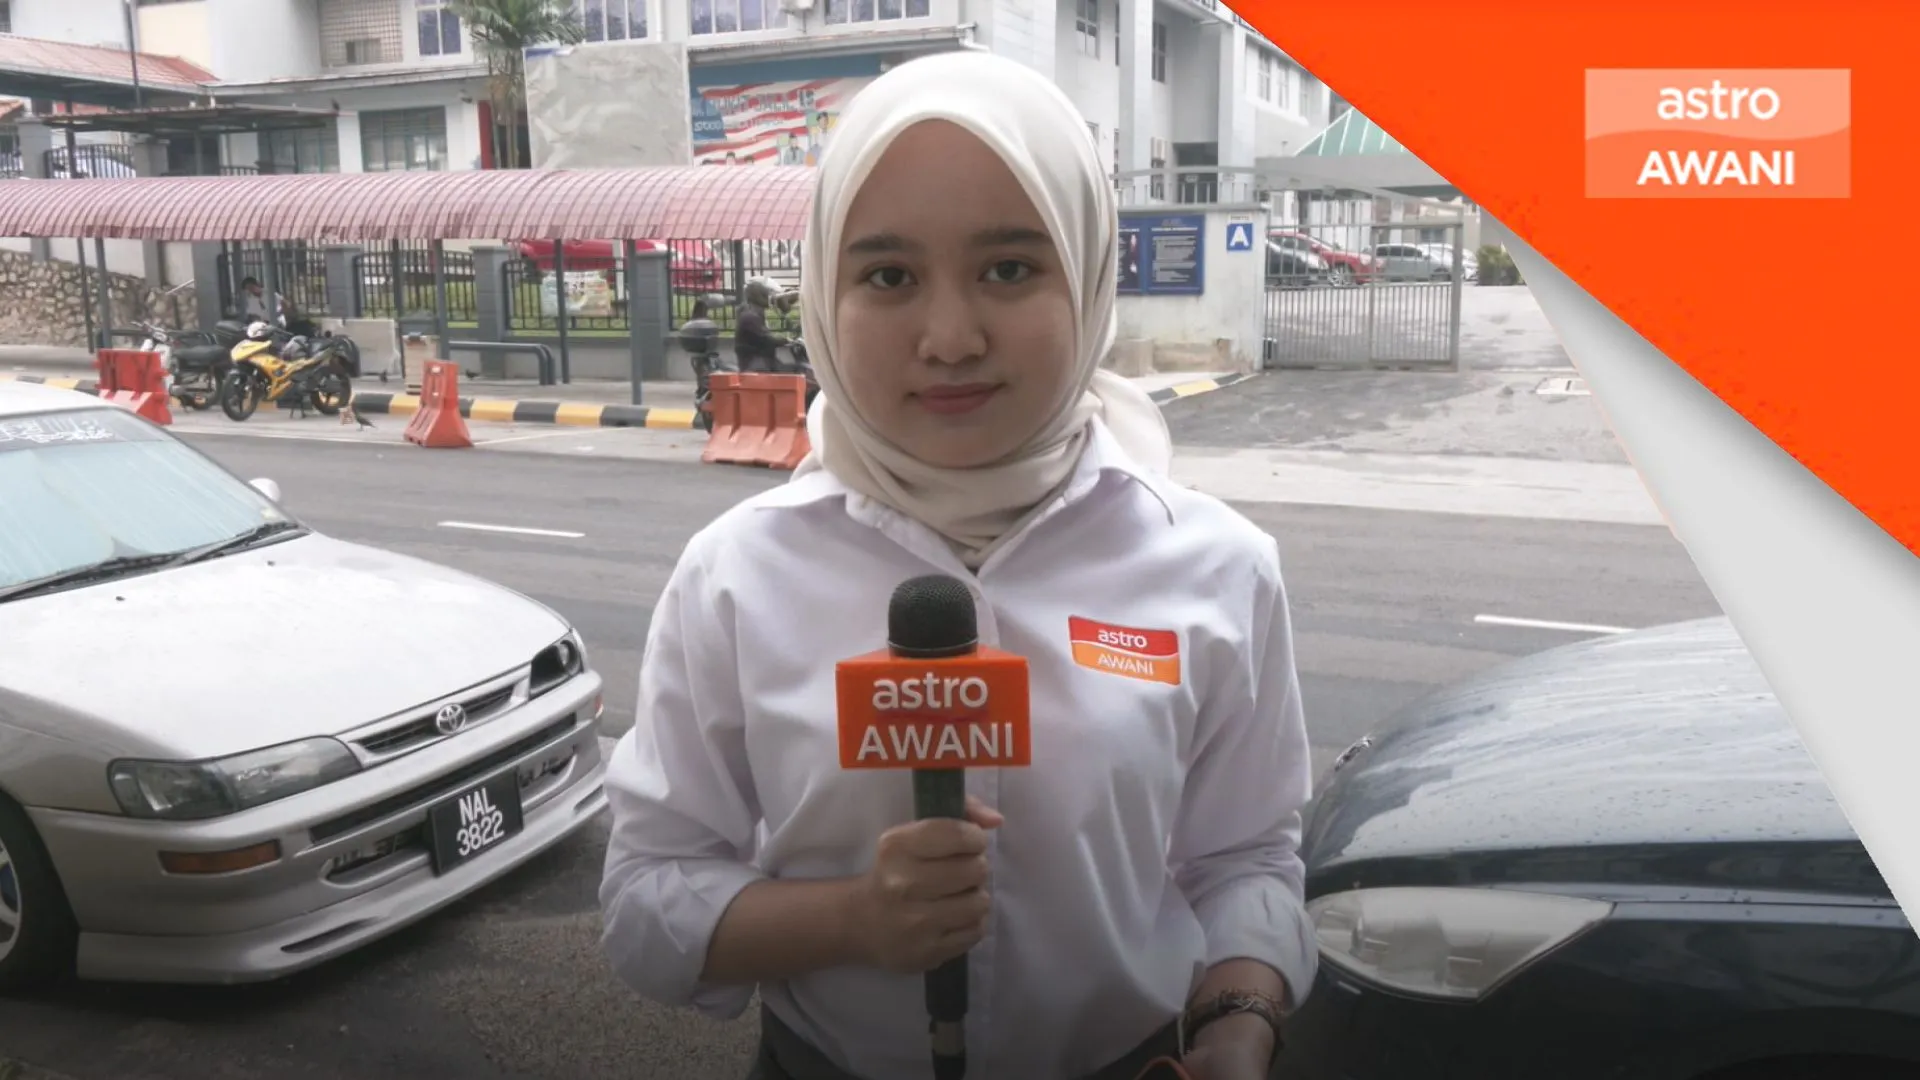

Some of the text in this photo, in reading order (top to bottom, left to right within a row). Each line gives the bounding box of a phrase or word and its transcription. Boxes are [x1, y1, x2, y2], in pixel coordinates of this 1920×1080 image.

[1229, 225, 1249, 247] A
[1098, 630, 1147, 648] astro
[1098, 654, 1154, 676] AWANI
[872, 672, 989, 710] astro
[856, 722, 1014, 761] AWANI
[459, 787, 496, 826] NAL
[456, 810, 504, 855] 3822
